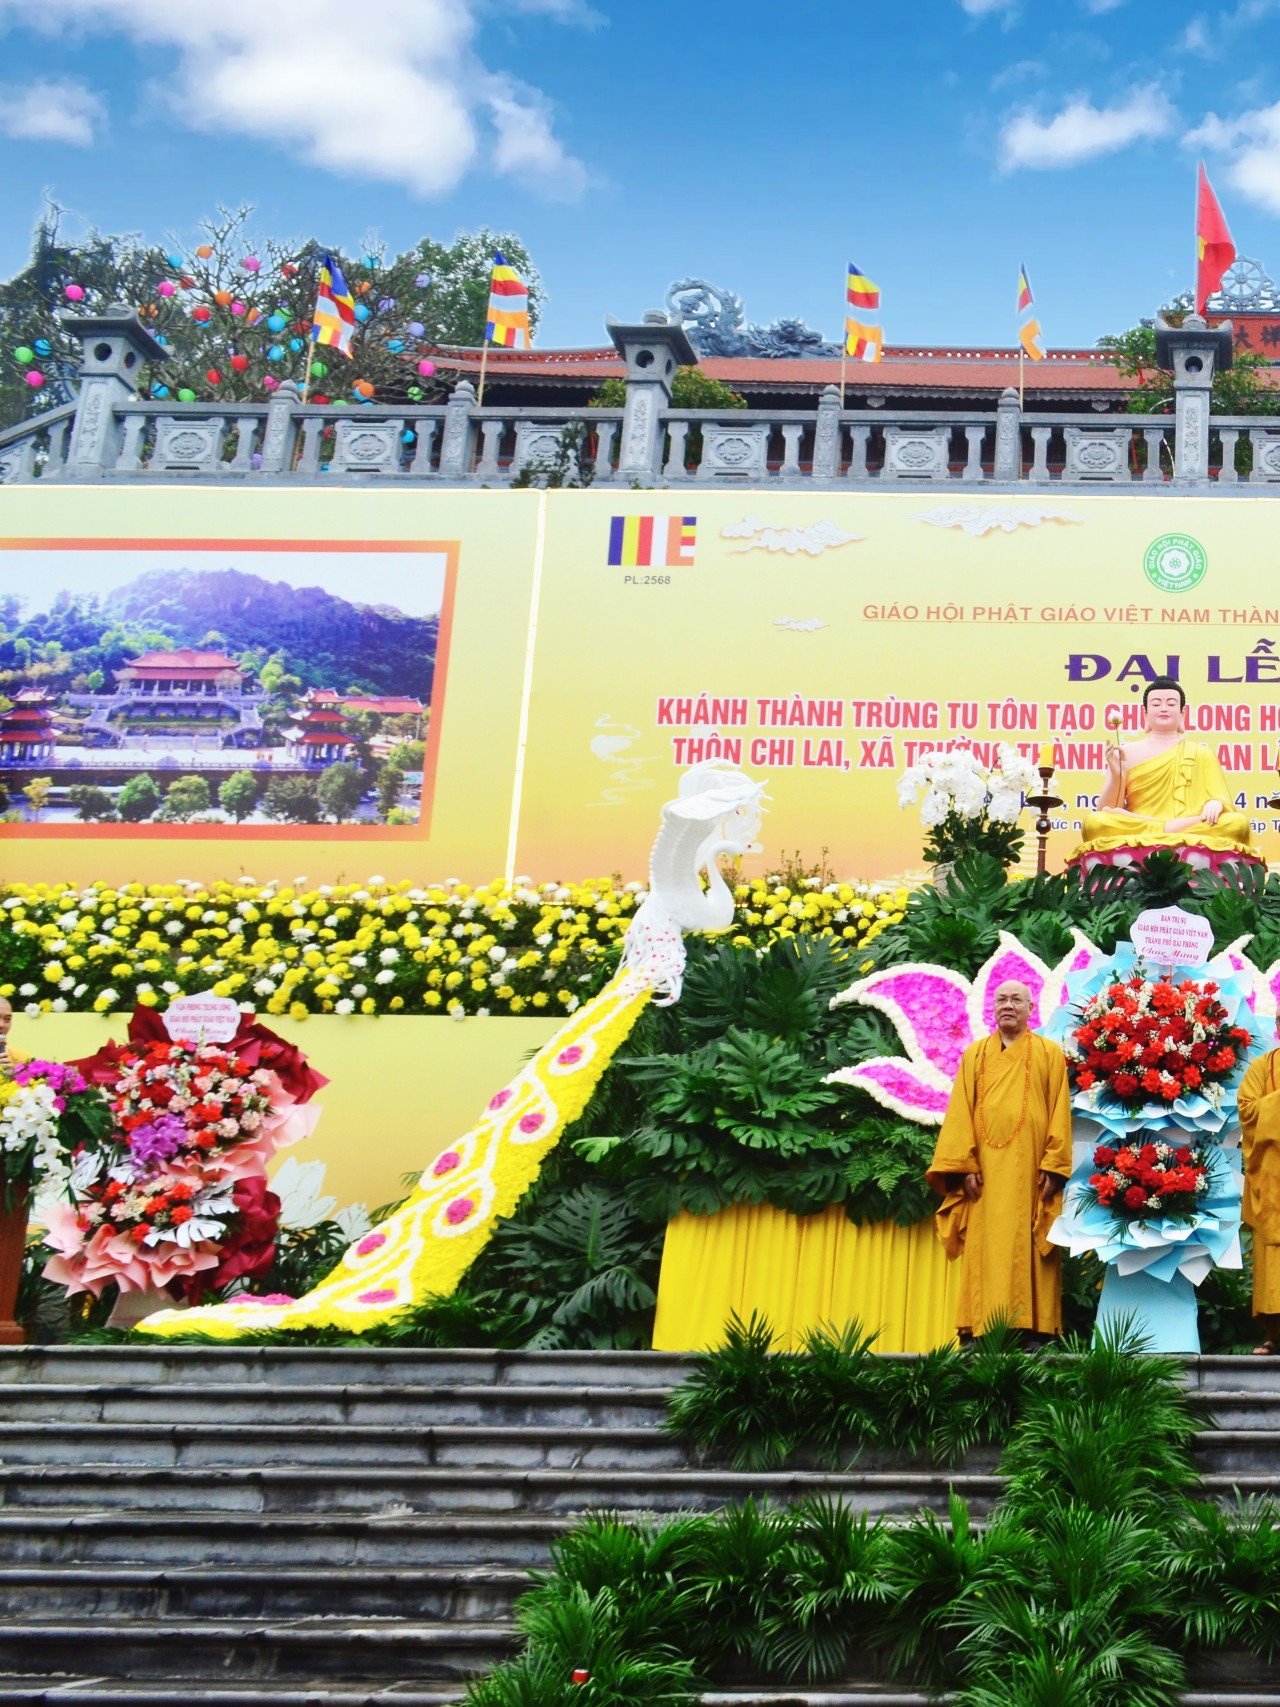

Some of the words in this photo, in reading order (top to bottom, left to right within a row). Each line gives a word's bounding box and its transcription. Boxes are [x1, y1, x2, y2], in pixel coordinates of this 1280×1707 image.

[624, 575, 671, 585] PL:2568
[863, 602, 919, 620] GIÁO
[926, 602, 964, 623] HỘI
[972, 603, 1033, 624] PHẬT
[1040, 604, 1096, 622] GIÁO
[1104, 604, 1153, 624] VIỆT
[1161, 608, 1210, 623] NAM
[1064, 654, 1180, 693] ĐẠI
[657, 693, 748, 725] KHÁNH
[757, 694, 843, 727] THÀNH
[852, 696, 938, 729] TRÙNG
[947, 703, 978, 729] TU
[987, 697, 1036, 730] TÔN
[1046, 703, 1095, 736] TẠO
[1184, 705, 1250, 732] LONG
[673, 732, 742, 765] THÔN
[751, 739, 794, 766] CHI
[803, 740, 850, 770] LAI,
[860, 735, 895, 767] XÃ
[1217, 744, 1251, 771] AN
